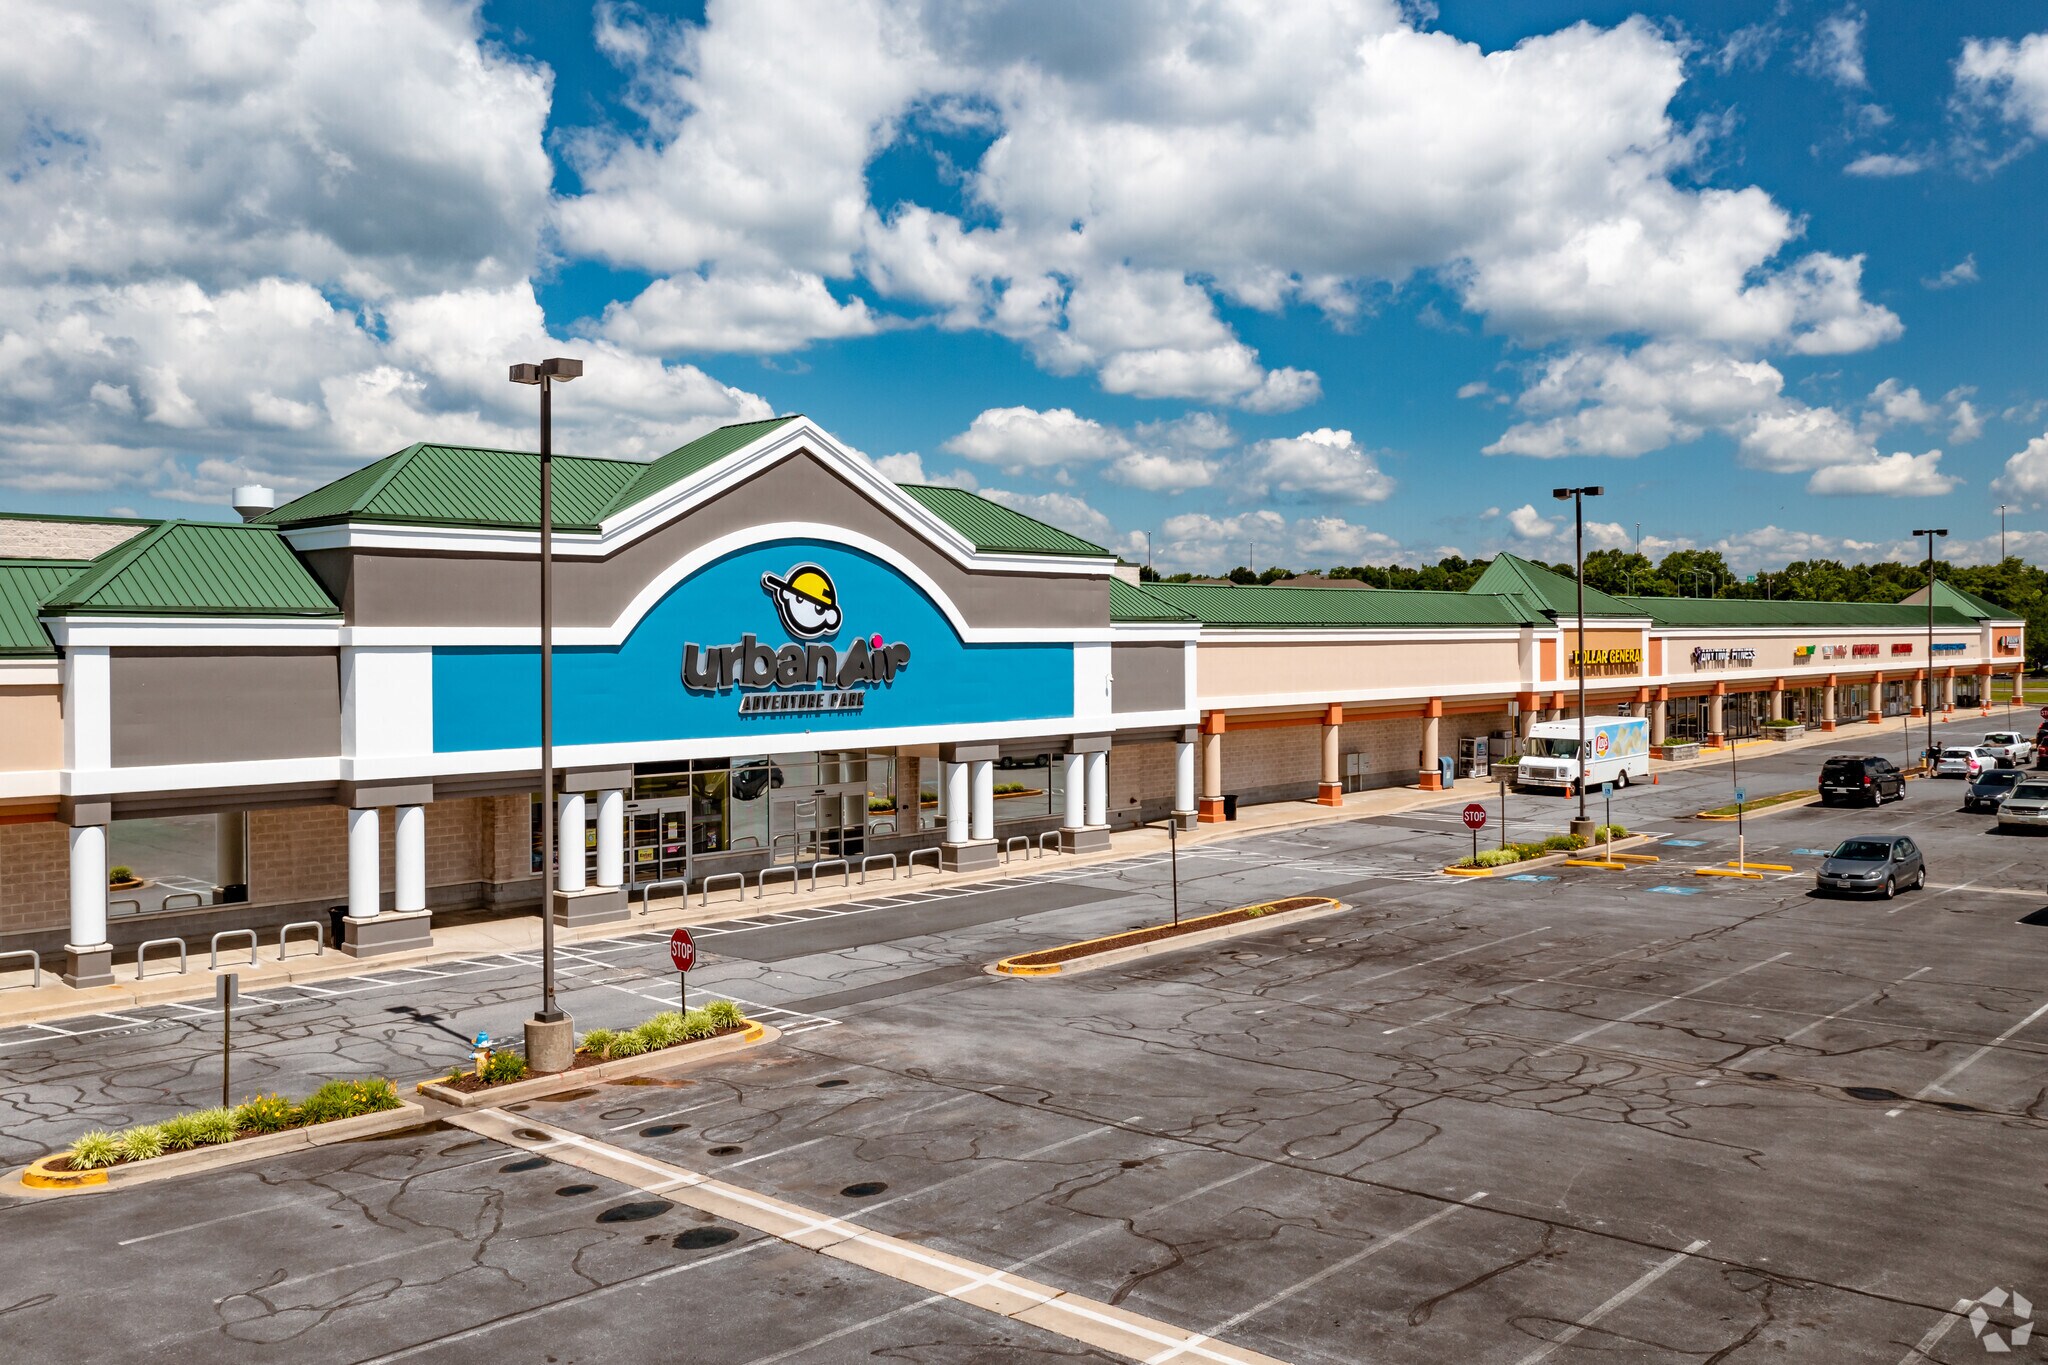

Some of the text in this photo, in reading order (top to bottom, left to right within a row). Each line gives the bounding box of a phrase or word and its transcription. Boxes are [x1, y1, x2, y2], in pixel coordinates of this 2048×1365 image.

[1574, 648, 1644, 664] DOLLAR GENERAL
[742, 691, 866, 711] ADVENTURE PARK
[1464, 811, 1485, 822] STOP
[671, 940, 693, 960] STOP
